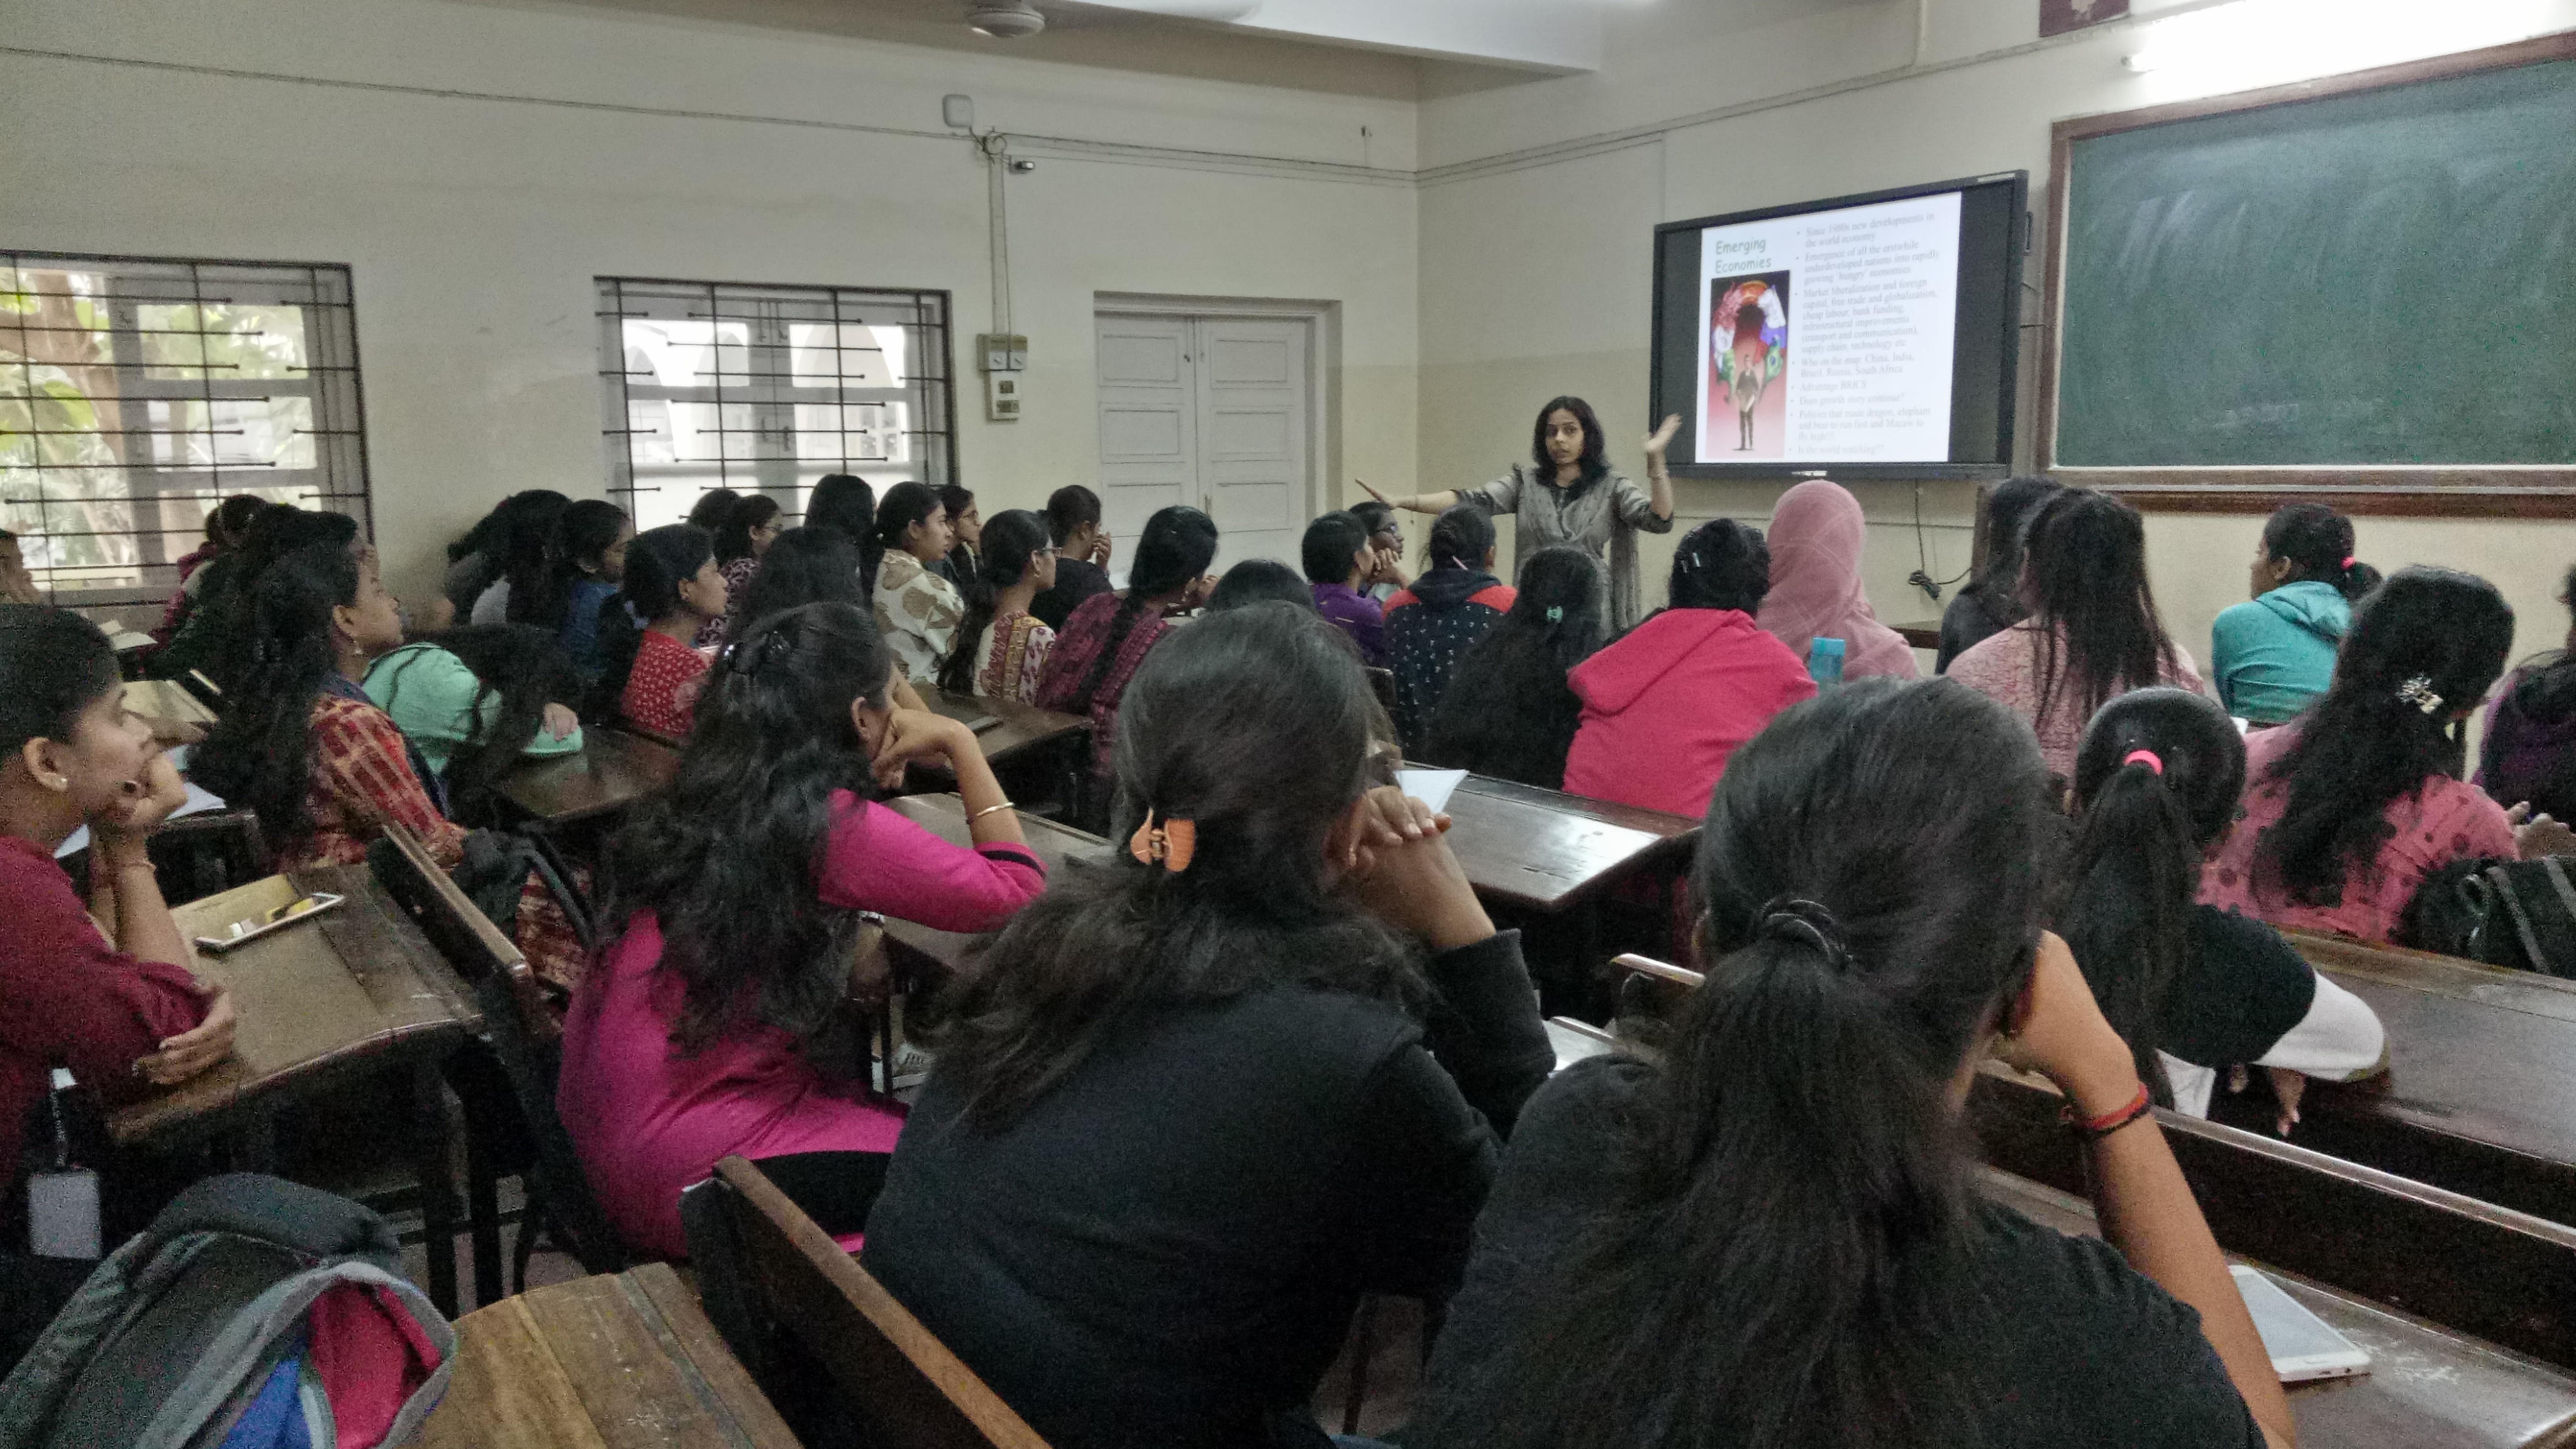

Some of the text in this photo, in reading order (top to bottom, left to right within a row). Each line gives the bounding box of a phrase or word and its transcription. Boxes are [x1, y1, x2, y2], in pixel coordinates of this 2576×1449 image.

[1806, 212, 1934, 236] Since 1980s new developments in
[1716, 238, 1766, 255] Emerging
[1806, 232, 1876, 247] the world economy
[1805, 240, 1919, 262] Emergence of all the erstwhile
[1716, 257, 1771, 274] Economies
[1805, 250, 1940, 273] underdeveloped nations into rapidly
[1804, 273, 1833, 286] growing
[1870, 266, 1911, 277] economies
[1804, 279, 1927, 297] Market liberalization and foreign
[1831, 297, 1845, 306] free
[1848, 296, 1866, 304] trade
[1868, 294, 1882, 303] and
[1803, 310, 1823, 321] cheap
[1853, 307, 1870, 316] bank
[1802, 315, 1909, 331] infrastructural improvements
[1802, 332, 1836, 343] (transport
[1839, 330, 1852, 339] and
[1802, 345, 1824, 355] supply
[1852, 340, 1892, 351] technology
[1802, 357, 1818, 367] Who
[1831, 355, 1842, 365] the
[1855, 366, 1877, 375] South
[1879, 365, 1902, 374] Africa
[1801, 380, 1867, 392] Advantage BRICS
[1801, 392, 1905, 407] Does growth story continue?
[1799, 411, 1826, 419] Policies
[1829, 409, 1843, 418] that
[1845, 409, 1864, 417] made
[1897, 407, 1931, 418] elephant
[1799, 421, 1811, 430] and
[1814, 421, 1829, 430] bear
[1855, 420, 1867, 429] fast
[1870, 419, 1883, 428] and
[1886, 419, 1913, 428] Macaw
[1799, 432, 1808, 441] fly
[1806, 446, 1818, 454] the
[1819, 445, 1840, 454] world
